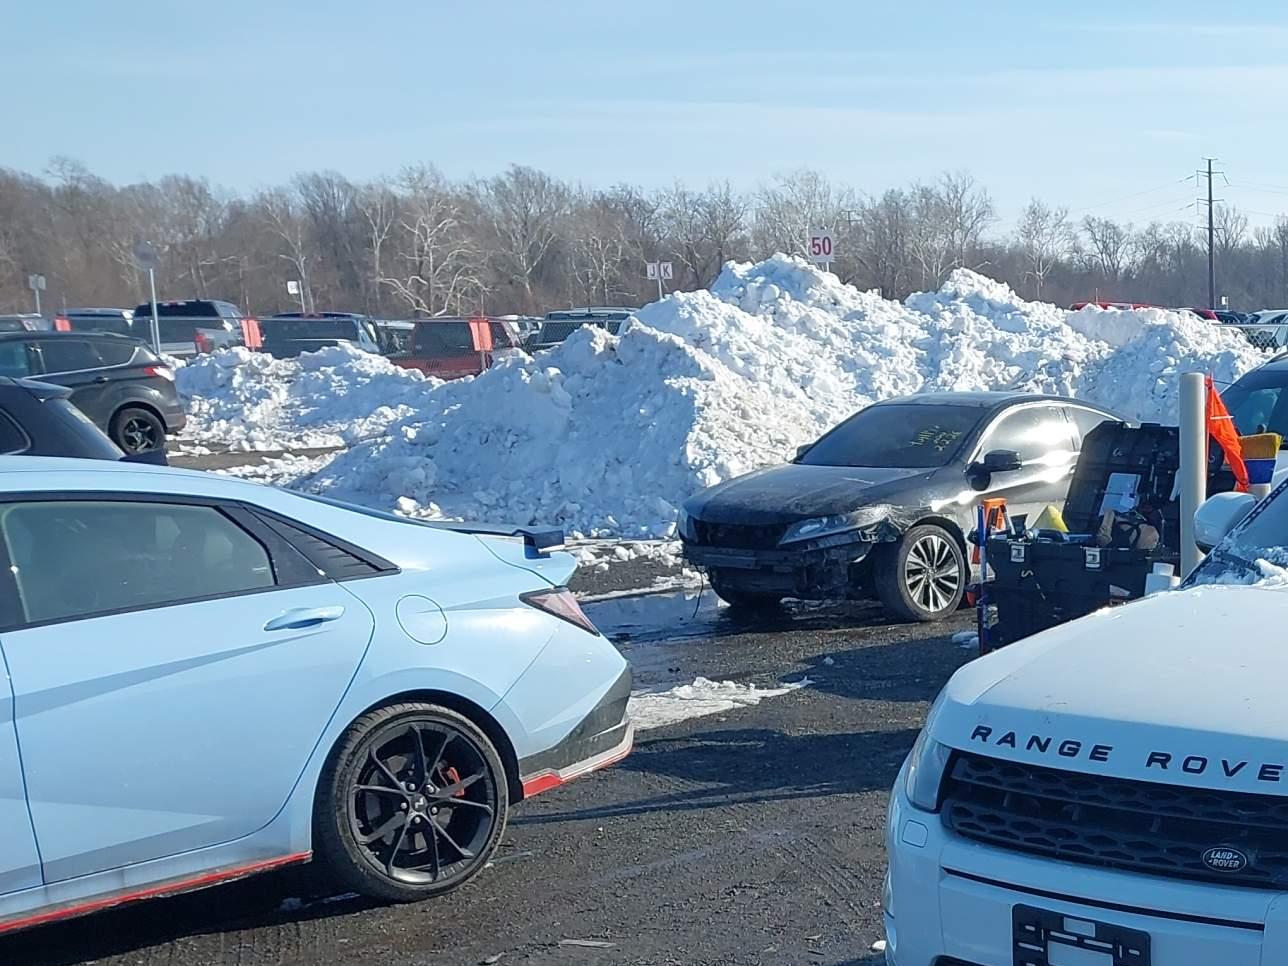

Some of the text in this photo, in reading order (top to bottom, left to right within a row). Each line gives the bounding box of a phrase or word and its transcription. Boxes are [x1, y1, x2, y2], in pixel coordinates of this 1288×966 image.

[811, 236, 831, 256] 50
[662, 264, 671, 277] K
[970, 725, 1114, 762] RANGE
[1210, 850, 1233, 860] LAND
[1212, 858, 1240, 868] ROVER
